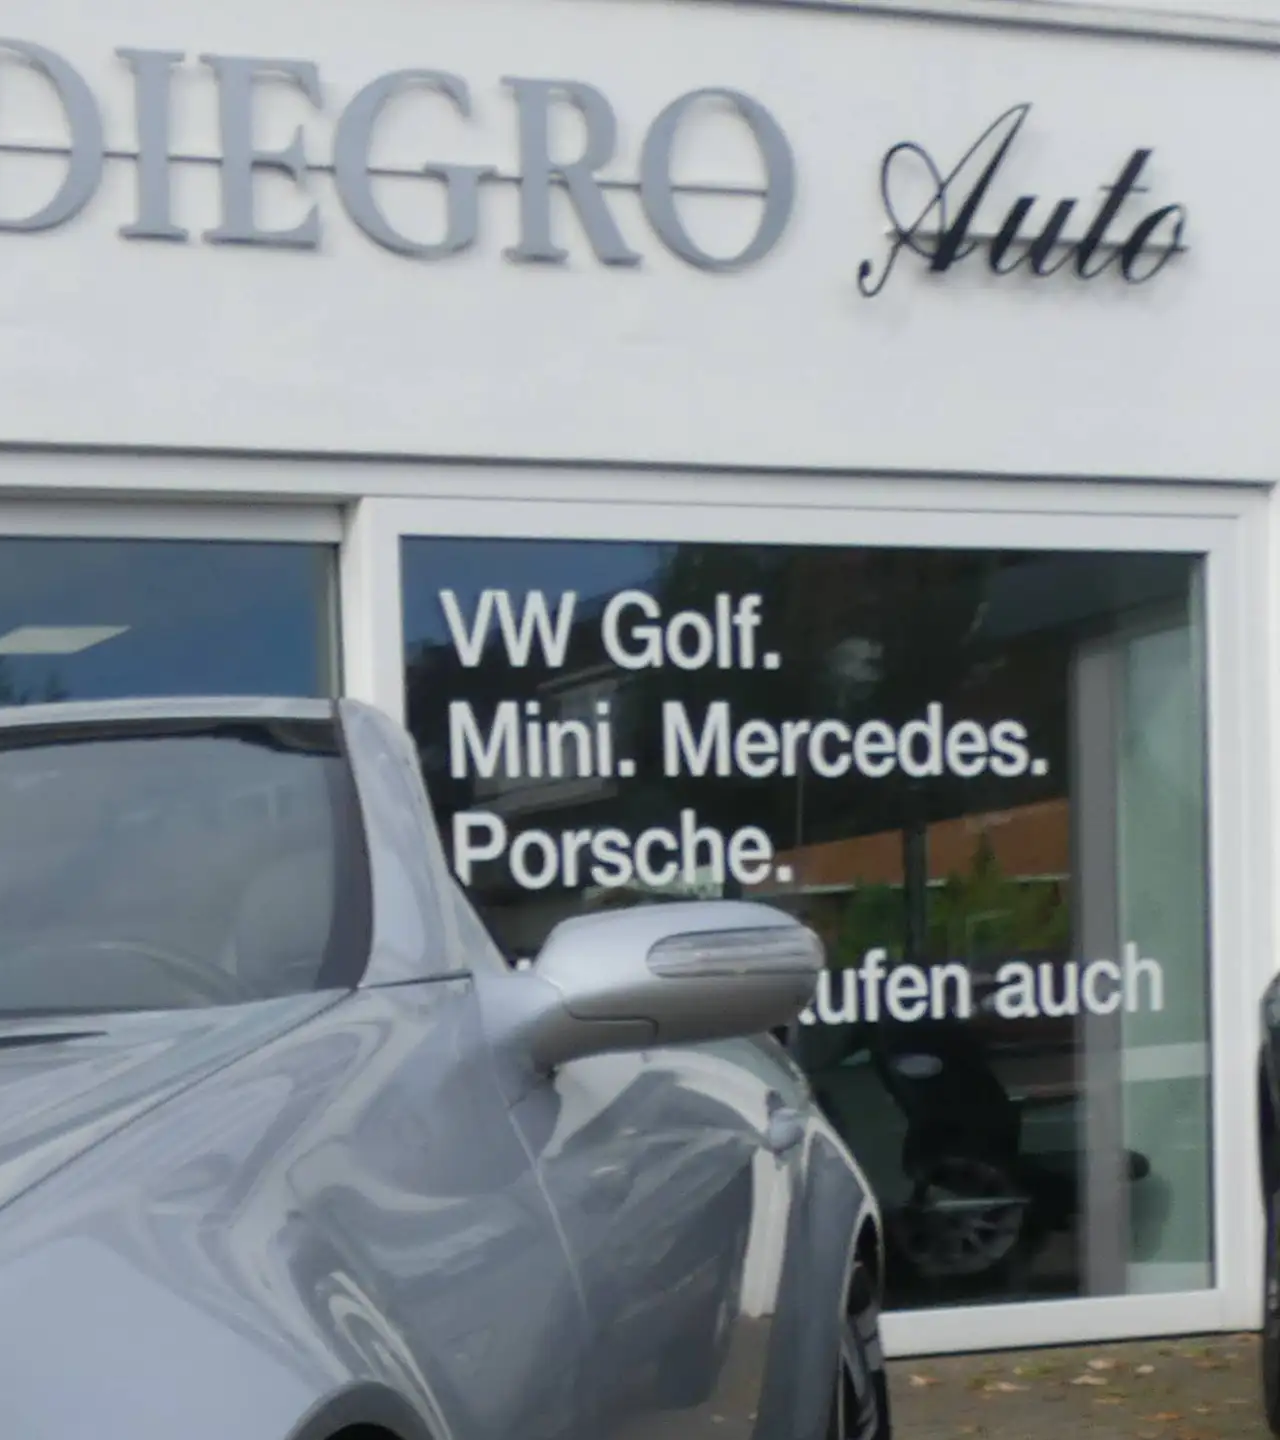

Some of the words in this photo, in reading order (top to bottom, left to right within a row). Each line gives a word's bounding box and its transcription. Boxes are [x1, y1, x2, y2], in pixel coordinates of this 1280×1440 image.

[857, 102, 1188, 297] Auto
[440, 588, 576, 669] VW
[601, 590, 782, 671] Golf.
[448, 700, 636, 779] Mini.
[662, 700, 1049, 779] Mercedes.
[452, 808, 794, 890] Porsche.
[798, 946, 972, 1026] ufen
[994, 942, 1164, 1018] auch
